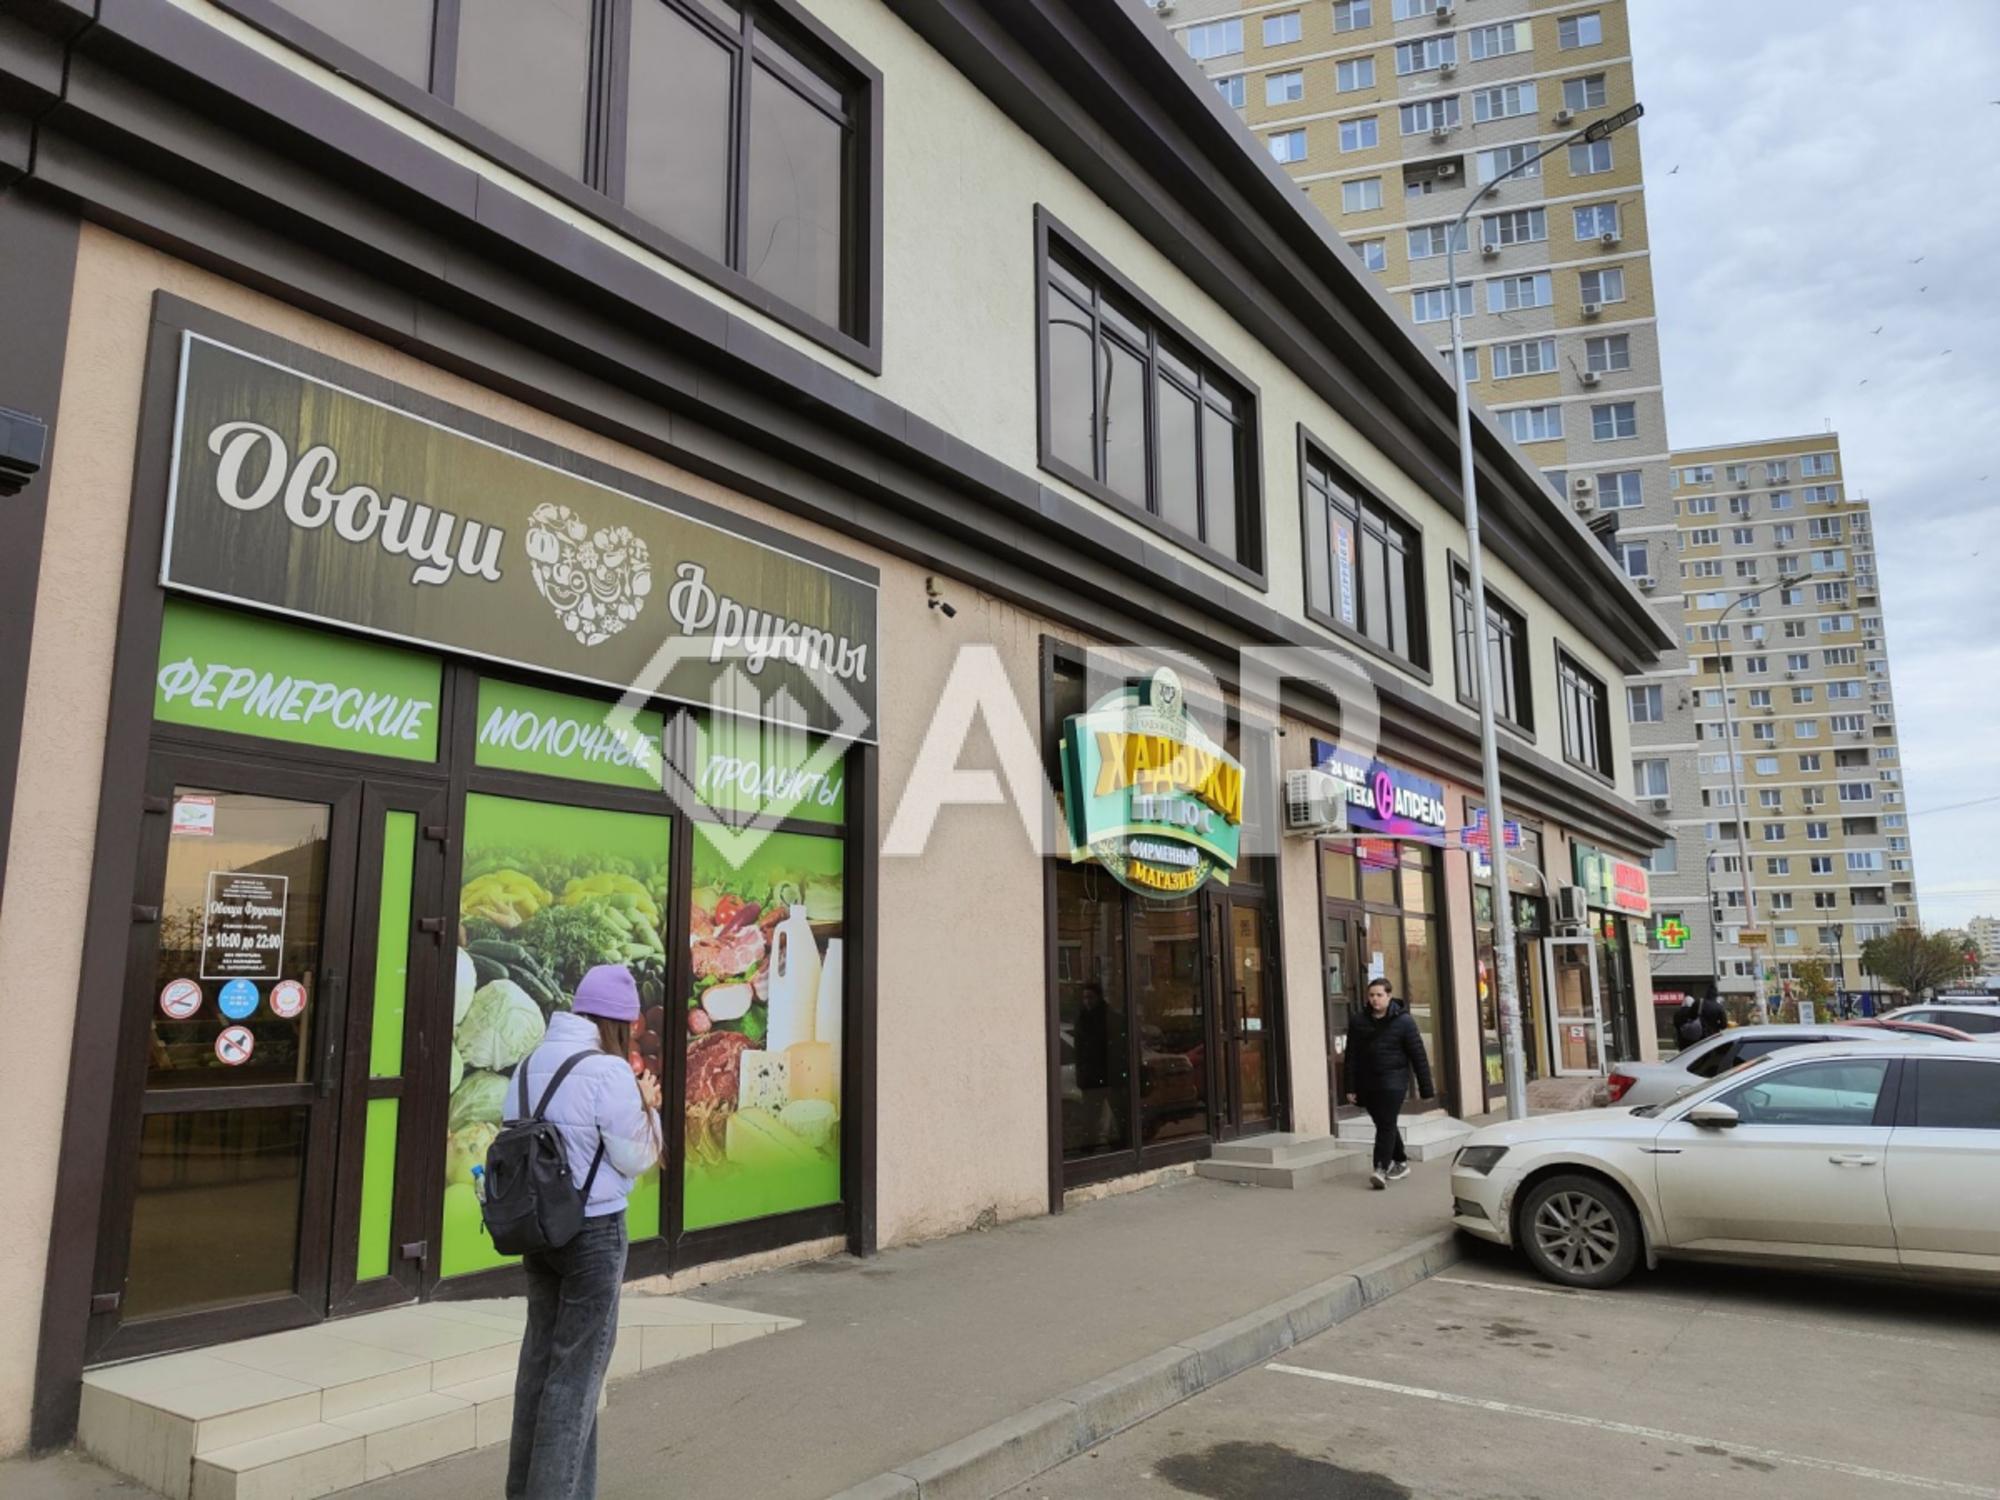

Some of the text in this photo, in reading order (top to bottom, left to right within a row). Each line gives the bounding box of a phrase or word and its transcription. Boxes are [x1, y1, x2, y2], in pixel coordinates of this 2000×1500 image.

[207, 421, 868, 683] Овощи Фрукты
[157, 657, 843, 806] ФЕРМЕРСКИЕ МОЛОЧНЫЕ ПРОДУКТЫ
[1096, 731, 1242, 825] ХАДЫЖИ
[1132, 795, 1214, 834] ПЛЮС
[1345, 783, 1446, 827] ТЕКА АПРЕЛЬ
[1129, 839, 1199, 867] ФИРМЕННЫЙ
[1127, 861, 1197, 892] МАГАЗИН
[216, 932, 241, 948] 10:00
[241, 937, 254, 951] до
[256, 933, 281, 949] 22:00
